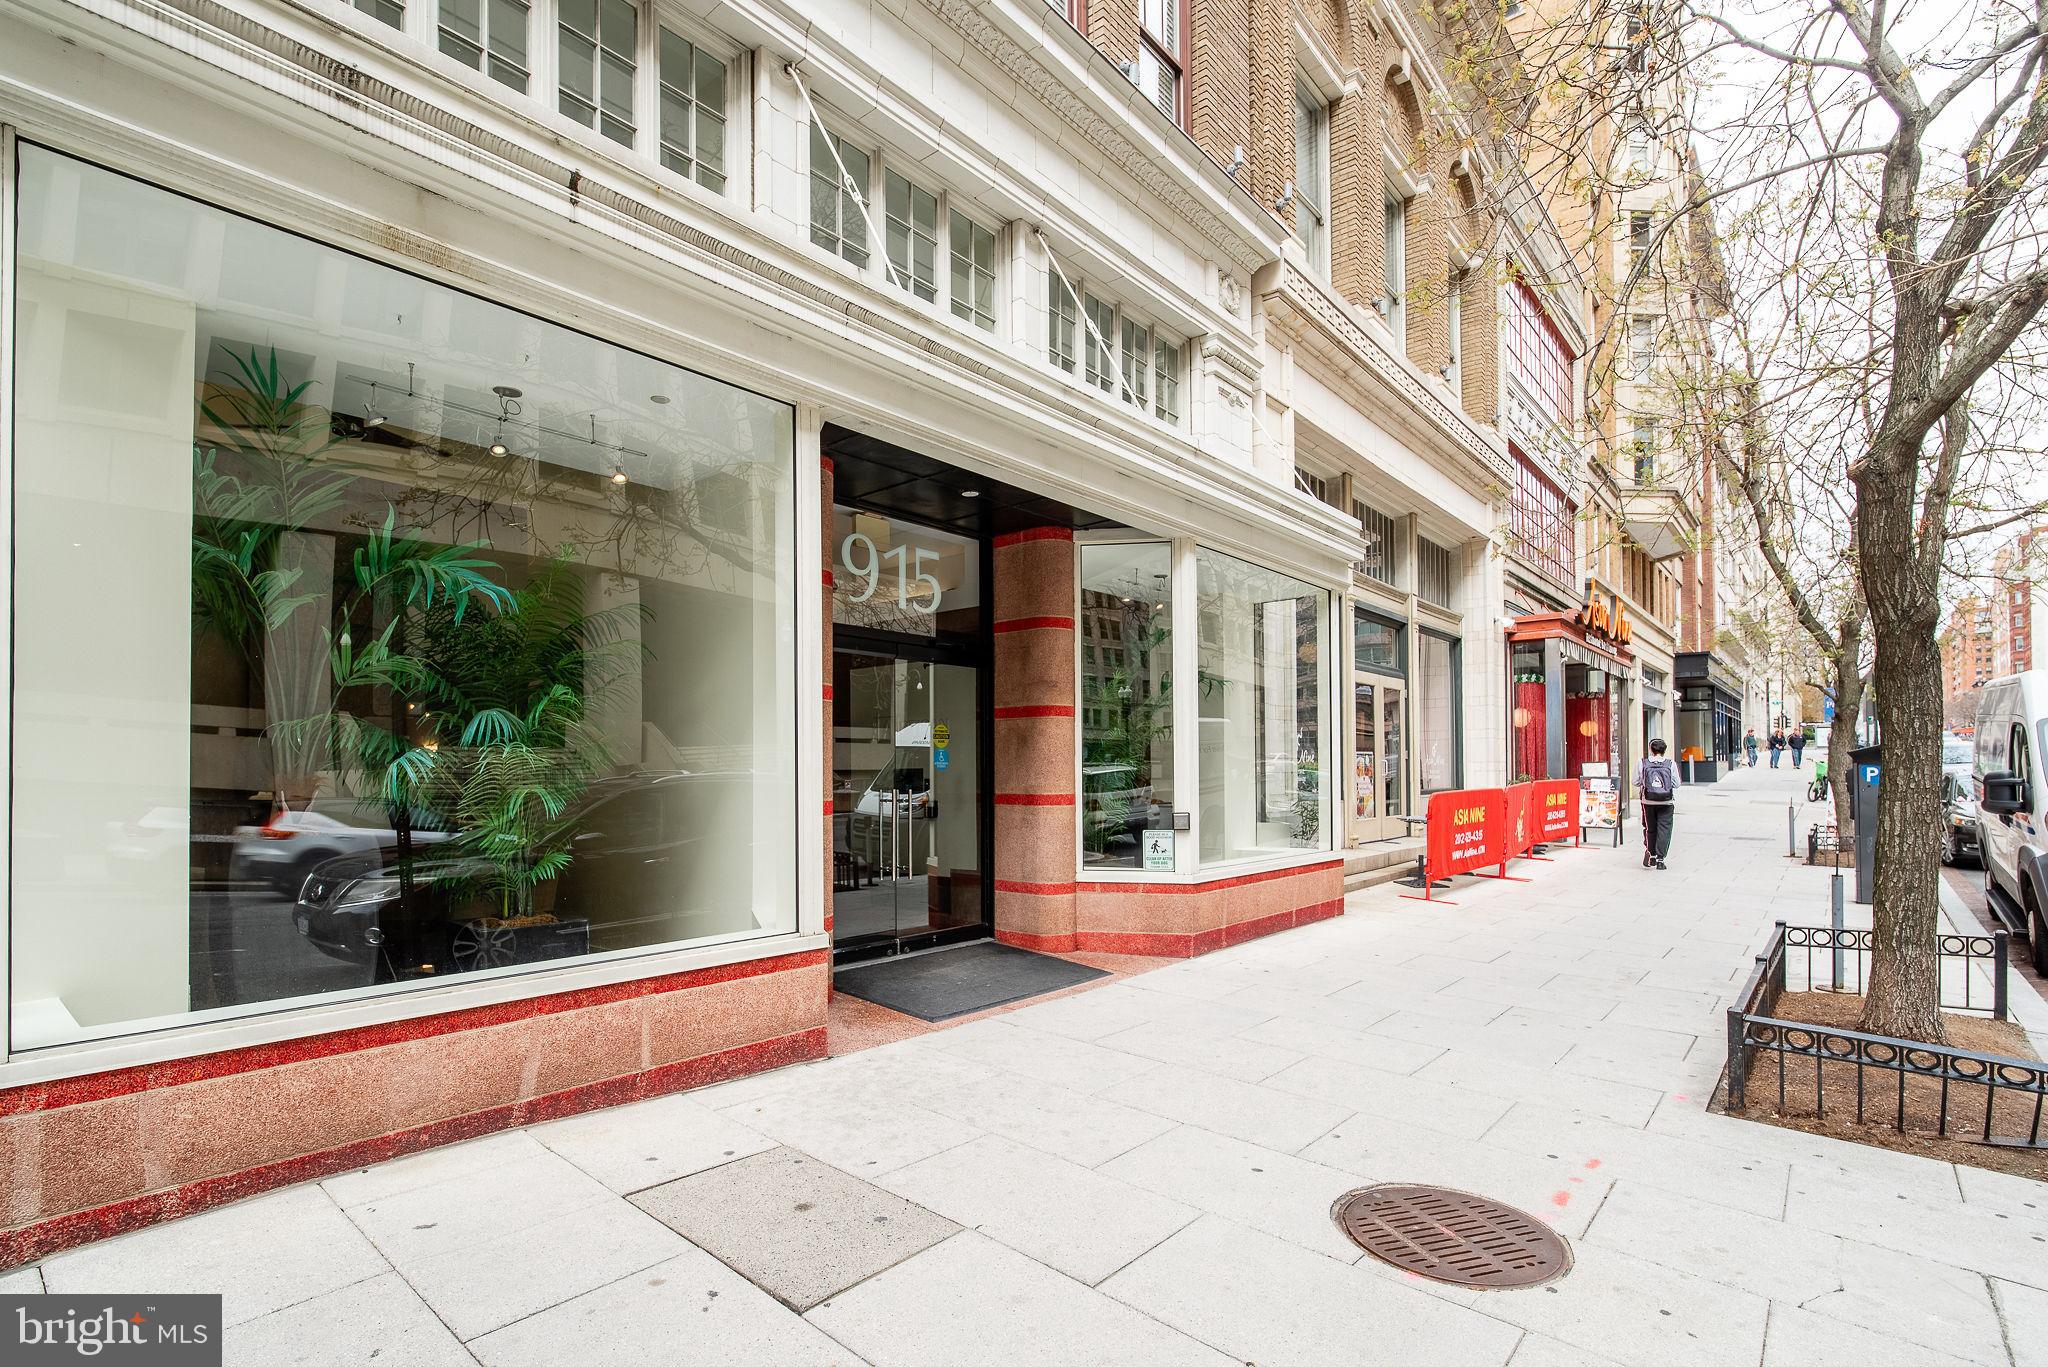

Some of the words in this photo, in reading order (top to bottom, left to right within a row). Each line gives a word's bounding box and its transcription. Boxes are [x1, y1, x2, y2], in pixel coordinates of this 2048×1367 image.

[841, 533, 942, 614] 915
[1866, 767, 1879, 782] P
[1546, 793, 1557, 807] ASIA
[1557, 792, 1567, 805] NINE
[1453, 808, 1469, 826] ASIA
[1470, 806, 1486, 823] NINE
